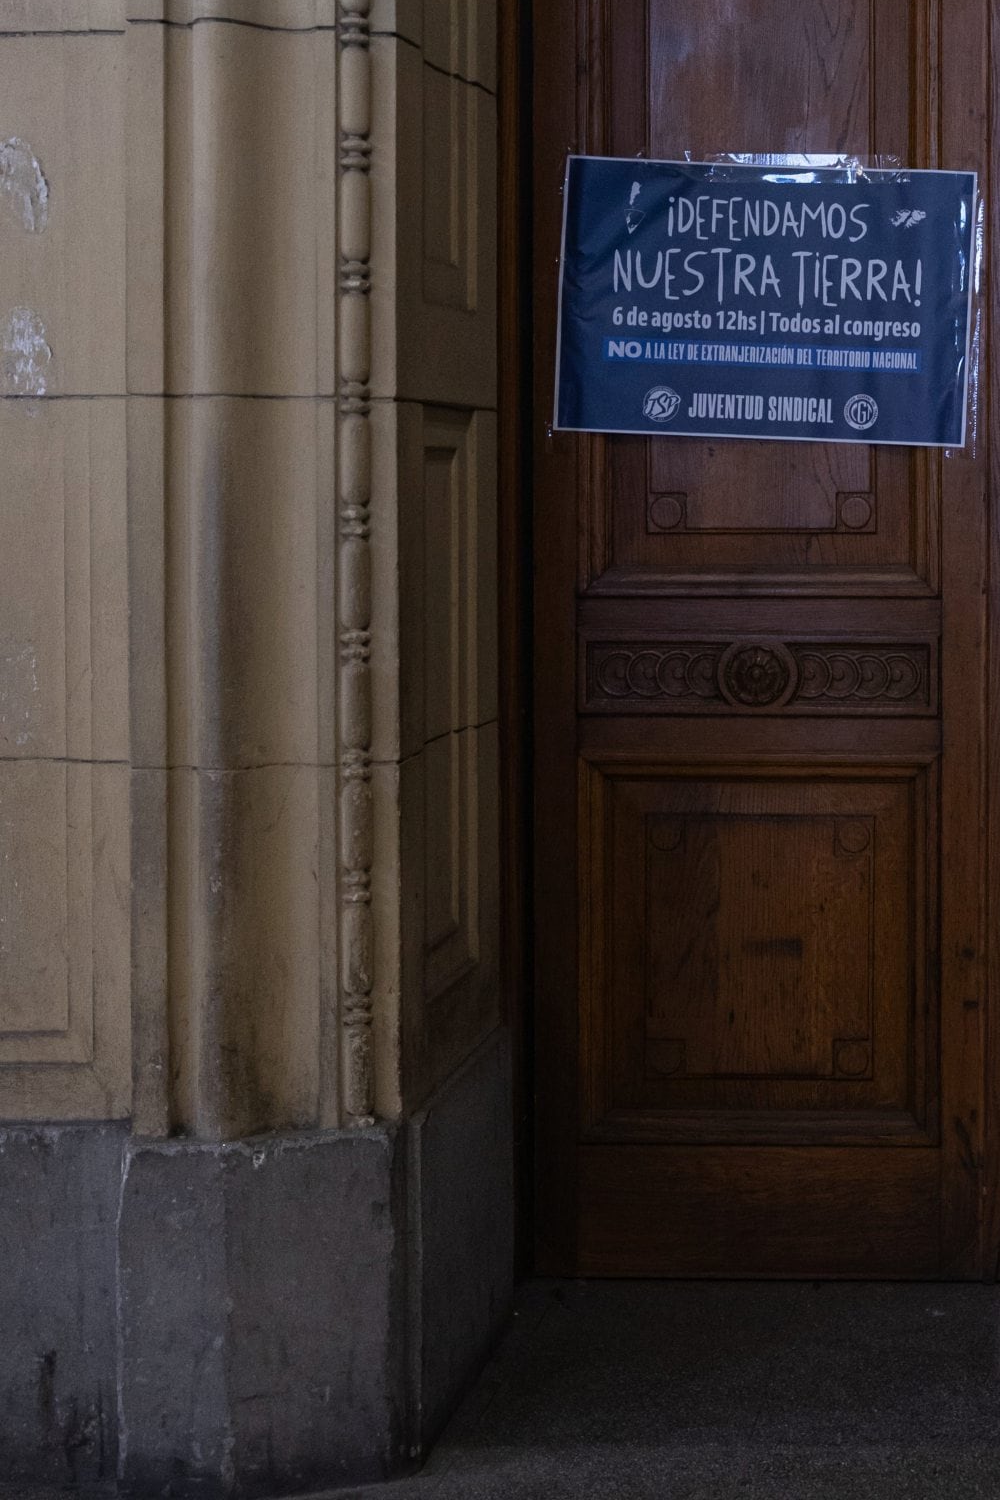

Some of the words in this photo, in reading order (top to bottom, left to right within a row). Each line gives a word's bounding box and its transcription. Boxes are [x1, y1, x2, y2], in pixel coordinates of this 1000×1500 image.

[668, 196, 870, 242] ¡DEFENDAMOS
[612, 247, 781, 305] NUESTRA
[612, 307, 624, 326] 6
[626, 307, 647, 327] de
[651, 311, 712, 333] agosto
[716, 309, 757, 331] 12hs
[768, 312, 821, 334] Todos
[824, 314, 840, 335] al
[843, 319, 921, 342] congreso
[608, 340, 643, 358] NO
[644, 342, 652, 359] A
[654, 342, 666, 360] LA
[668, 343, 685, 360] LEY
[687, 344, 699, 361] DE
[701, 344, 795, 365] EXTRANJERIZACIÓN
[796, 348, 813, 365] DEL
[815, 349, 871, 368] TERRITORIO
[872, 351, 918, 370] NACIONAL
[688, 393, 764, 421] JUVENTUD
[767, 396, 834, 424] SINDICAL
